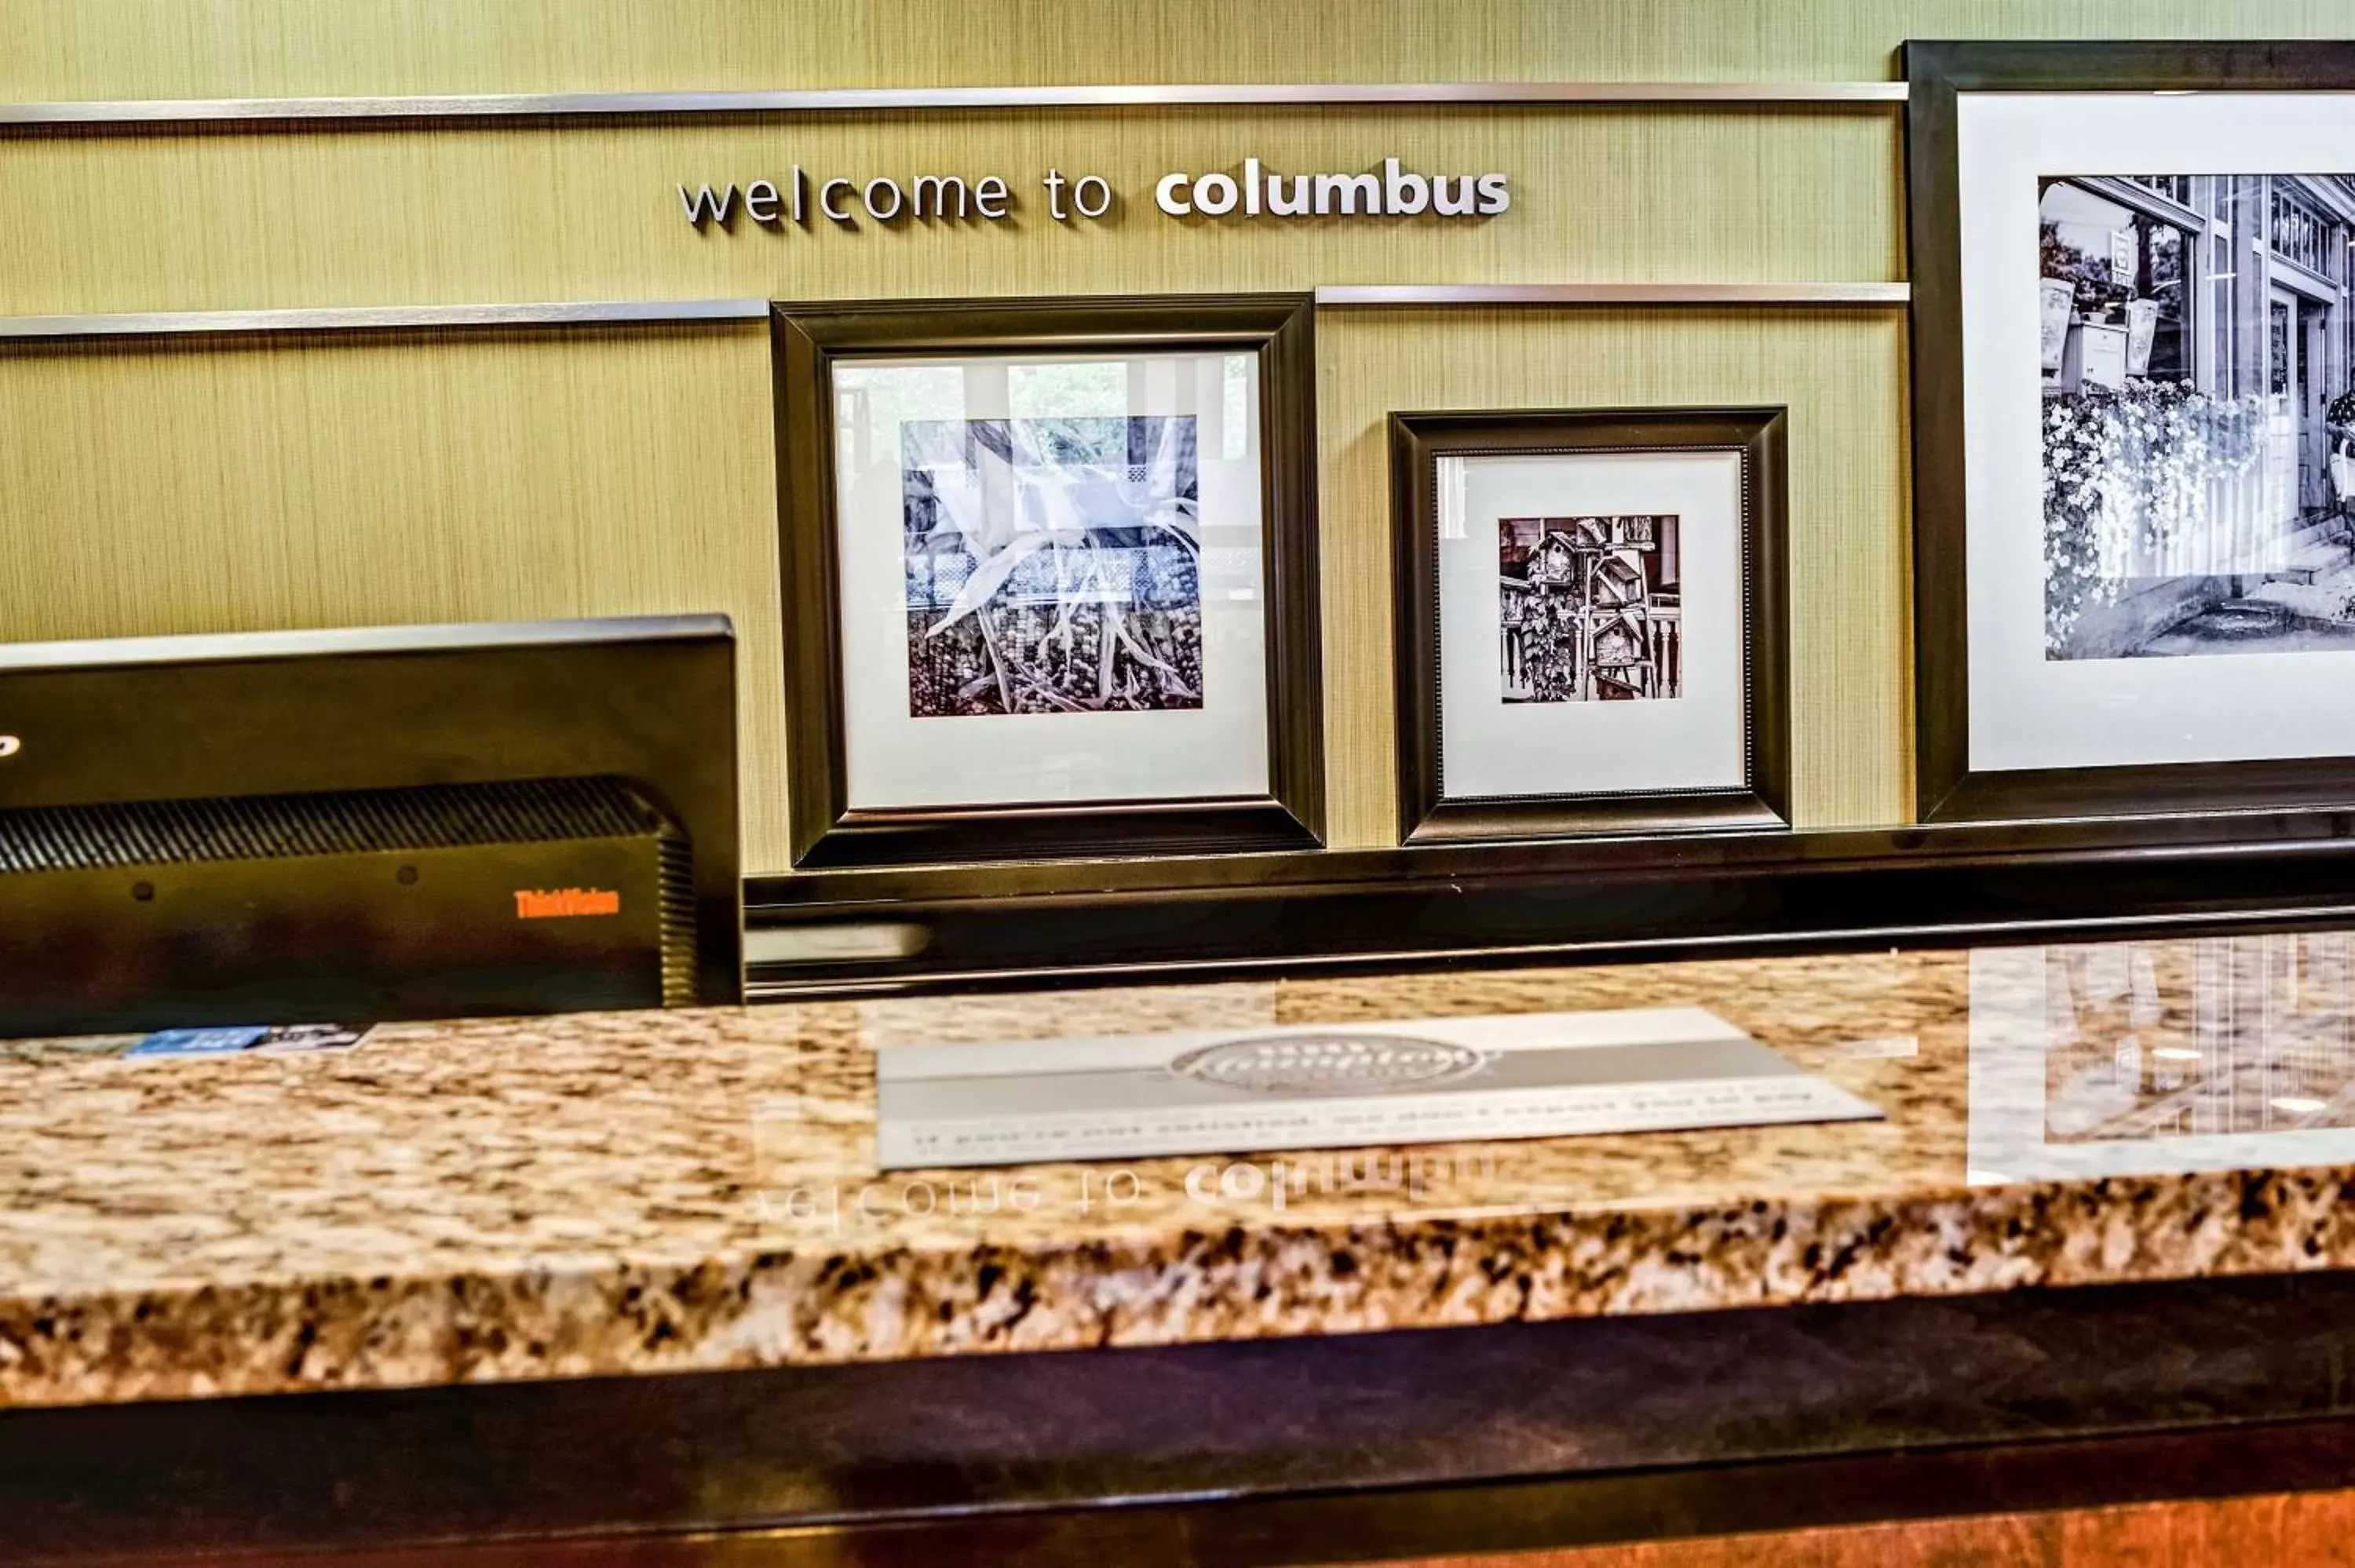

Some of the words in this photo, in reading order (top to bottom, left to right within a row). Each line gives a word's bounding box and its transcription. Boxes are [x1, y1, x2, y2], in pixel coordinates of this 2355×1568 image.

[676, 163, 1008, 223] welcome
[1042, 167, 1112, 220] to
[1156, 157, 1511, 216] columbus
